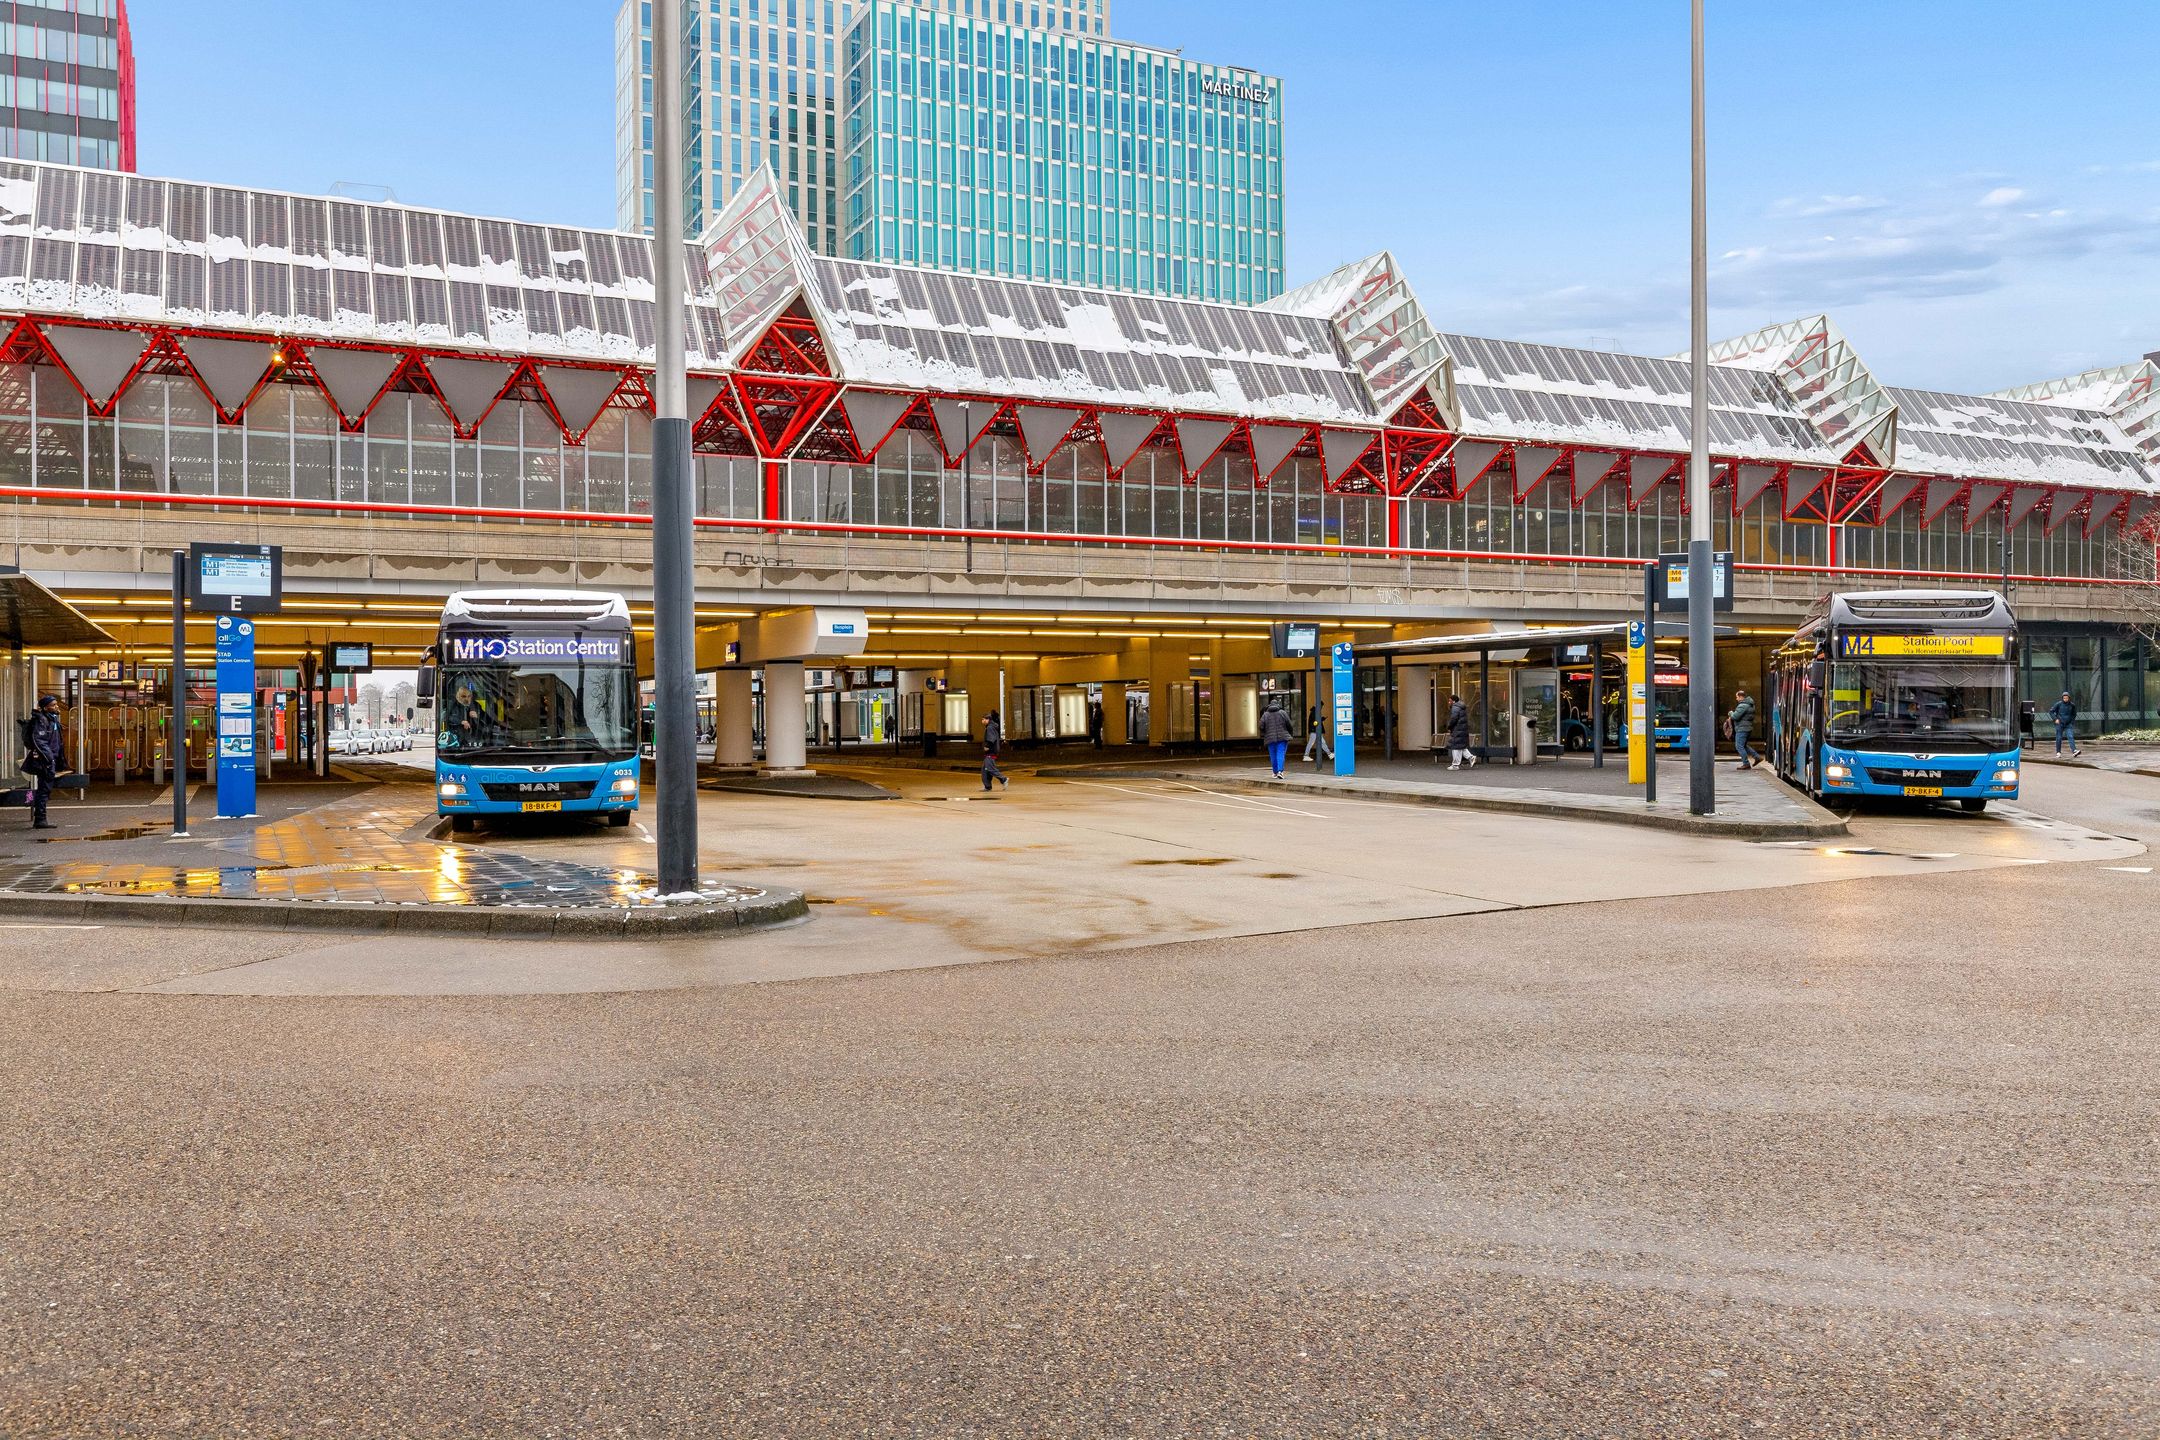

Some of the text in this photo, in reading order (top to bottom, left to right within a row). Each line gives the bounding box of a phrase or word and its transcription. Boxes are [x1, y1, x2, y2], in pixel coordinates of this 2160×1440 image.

[1201, 78, 1270, 104] MARTINEZ
[231, 595, 242, 611] E
[218, 634, 242, 642] allGo
[1903, 635, 1973, 646] Station Poort
[453, 638, 619, 659] M1 Station Centru
[1843, 634, 1875, 655] M4
[1297, 649, 1304, 658] D
[480, 772, 516, 784] allGo
[1902, 769, 1942, 778] MAN
[519, 783, 560, 792] MAN
